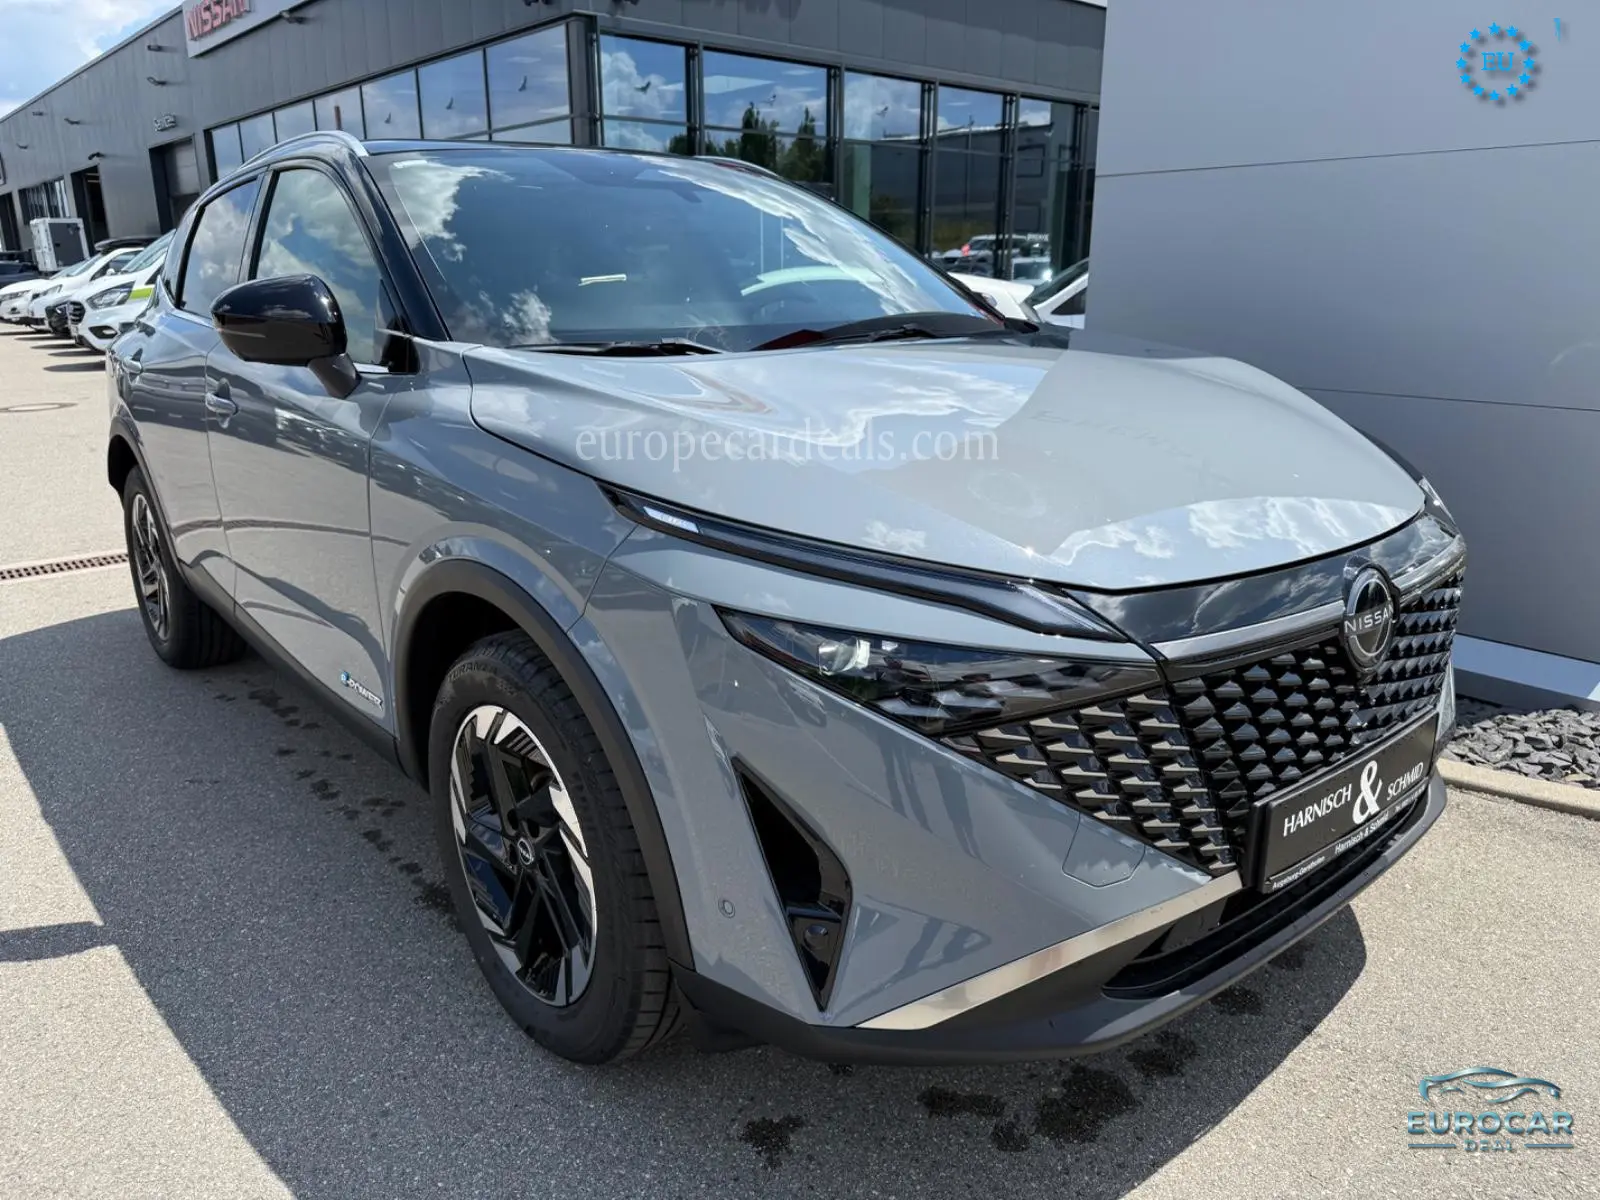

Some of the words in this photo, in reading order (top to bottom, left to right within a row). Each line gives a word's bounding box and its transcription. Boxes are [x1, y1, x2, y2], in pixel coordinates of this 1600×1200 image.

[1283, 783, 1352, 837] HARNISCH
[1352, 760, 1383, 825] &
[1386, 761, 1424, 801] SCHMID
[1334, 831, 1364, 855] Harnisch
